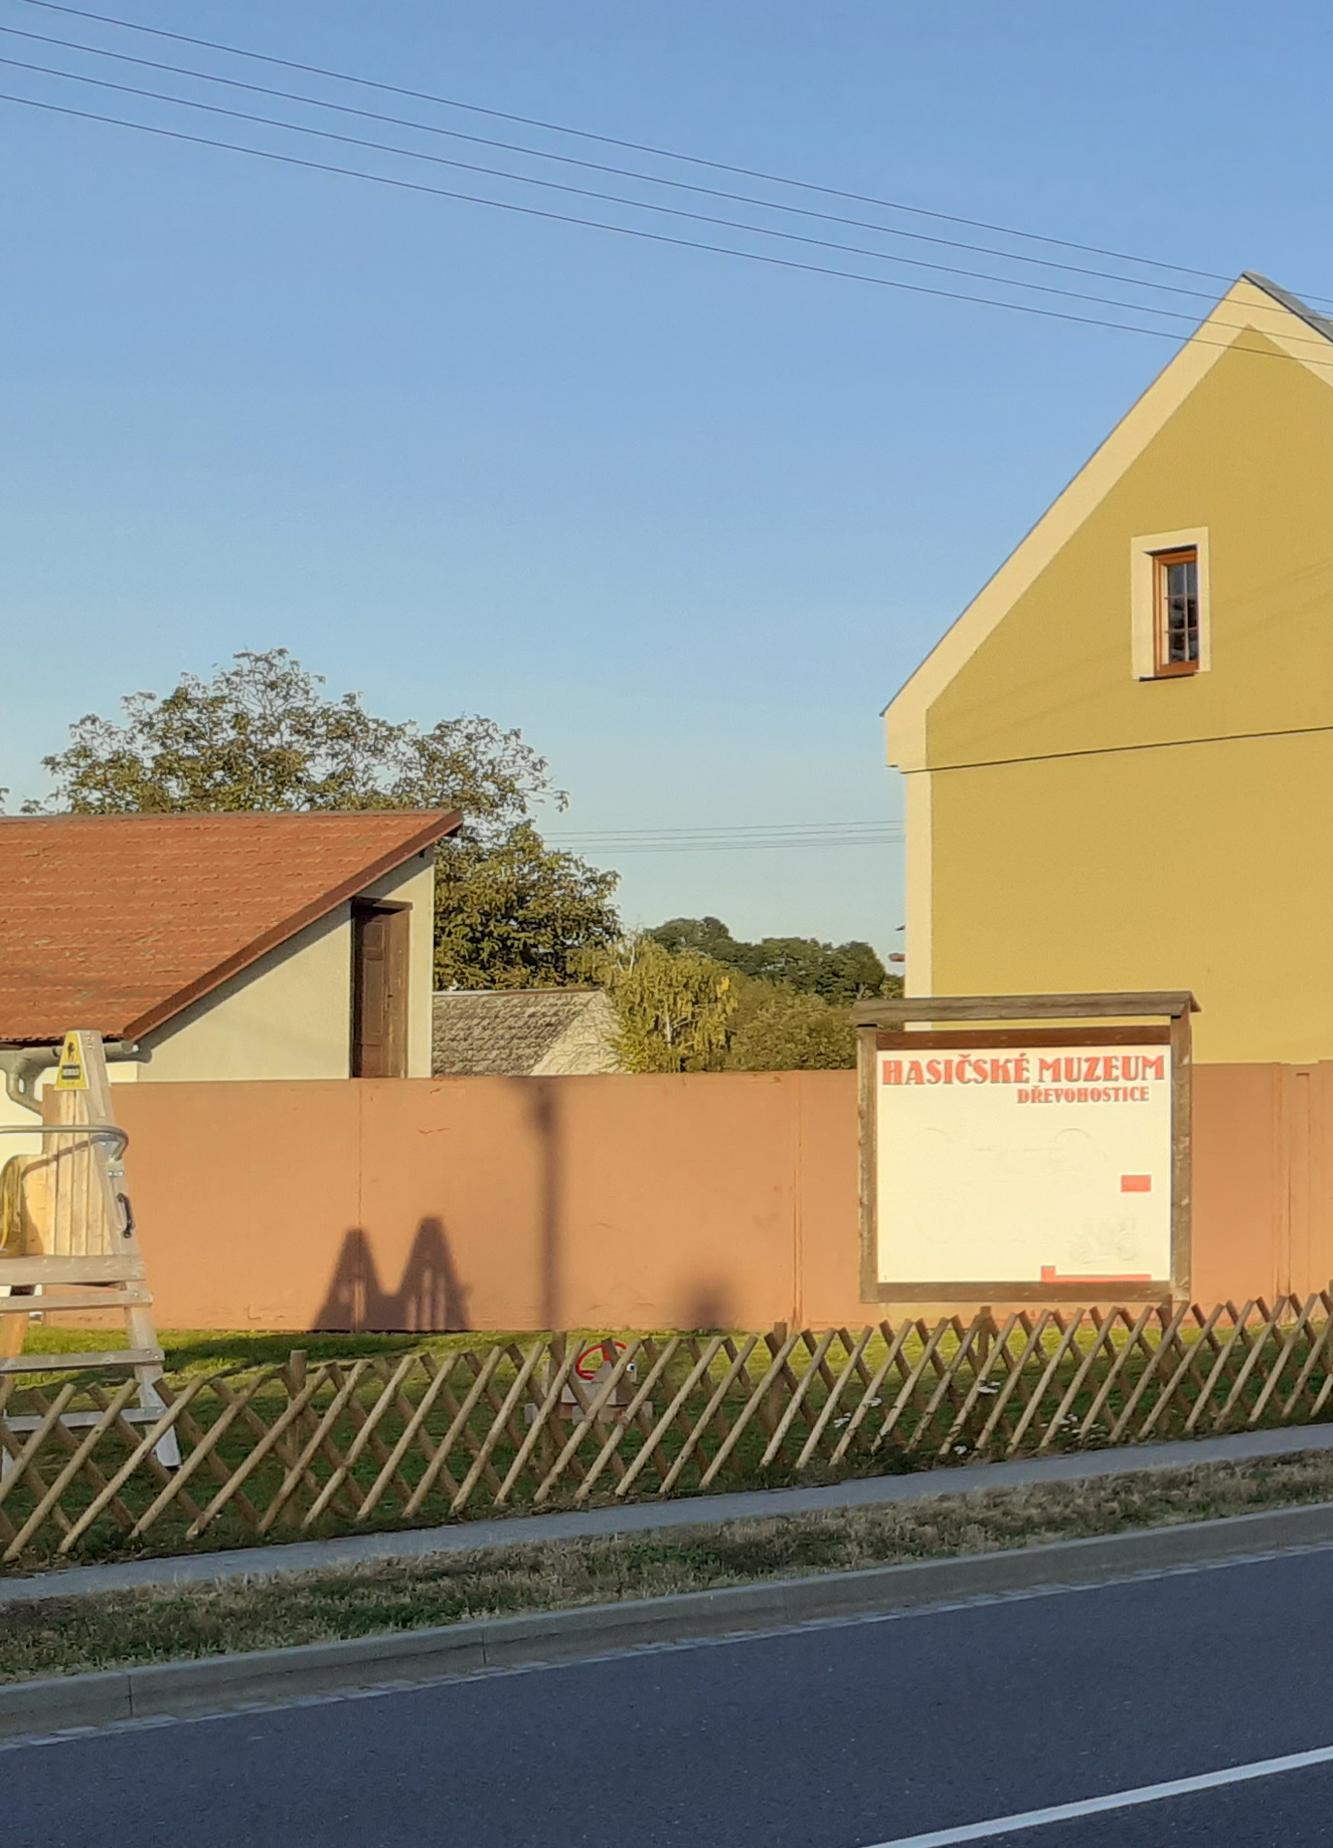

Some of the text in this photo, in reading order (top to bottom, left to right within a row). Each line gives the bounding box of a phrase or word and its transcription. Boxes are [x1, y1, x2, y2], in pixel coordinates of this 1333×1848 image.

[882, 1052, 1165, 1086] HASIČSKÉ MUZEUM
[1016, 1085, 1150, 1104] DŘEVOHOSTICE
